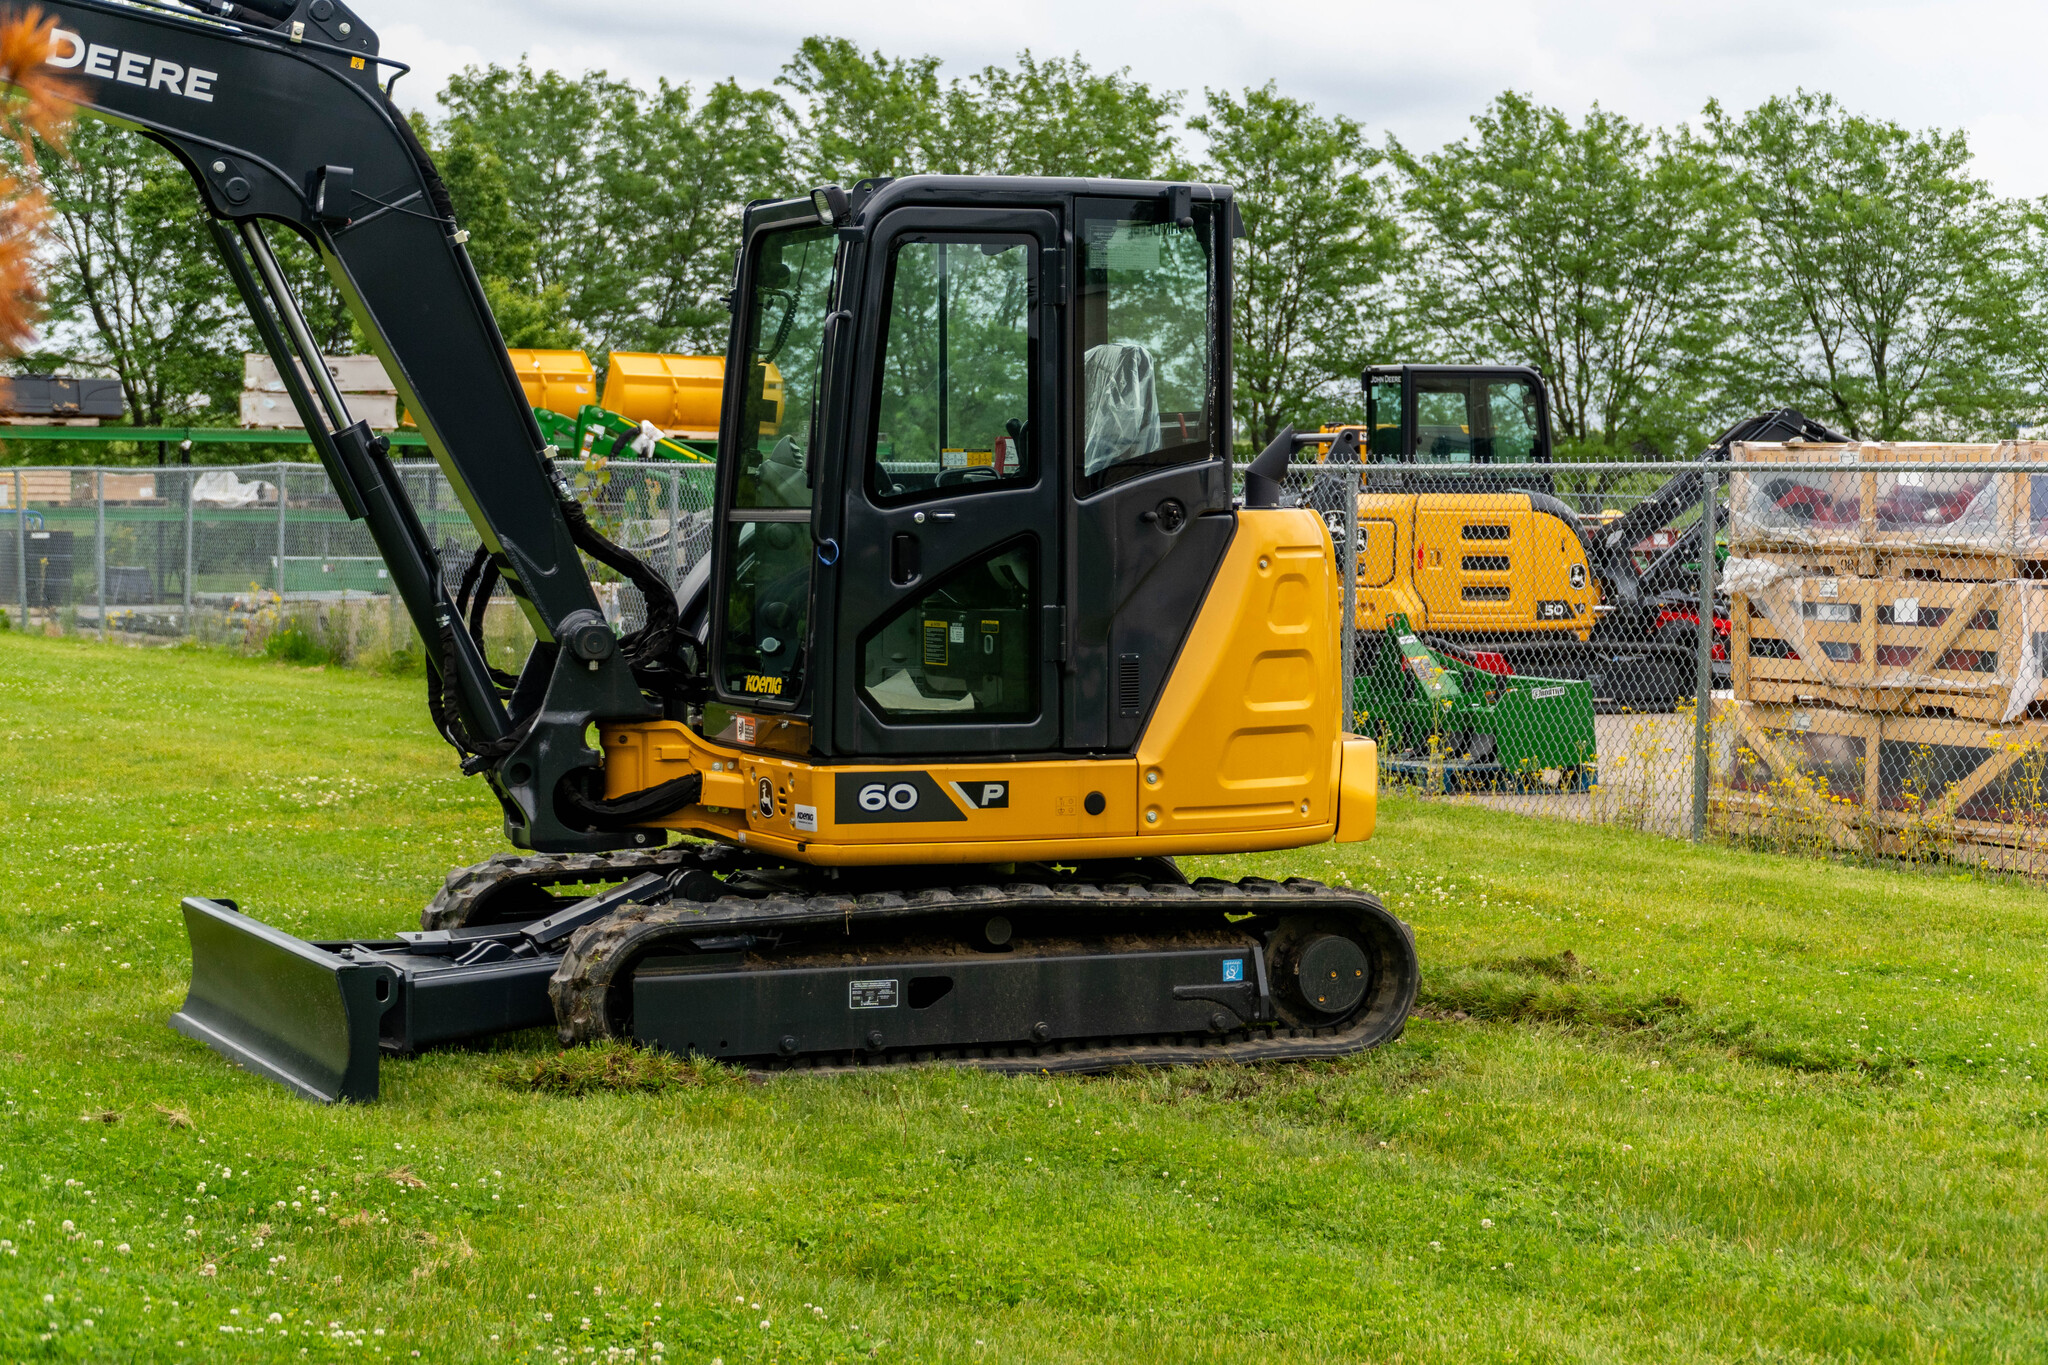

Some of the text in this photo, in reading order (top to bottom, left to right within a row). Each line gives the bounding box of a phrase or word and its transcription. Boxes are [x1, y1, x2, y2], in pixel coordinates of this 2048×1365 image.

[45, 28, 218, 102] DEERE
[1384, 374, 1402, 383] DEERE
[1544, 604, 1564, 616] 50
[858, 782, 1005, 812] 60 P
